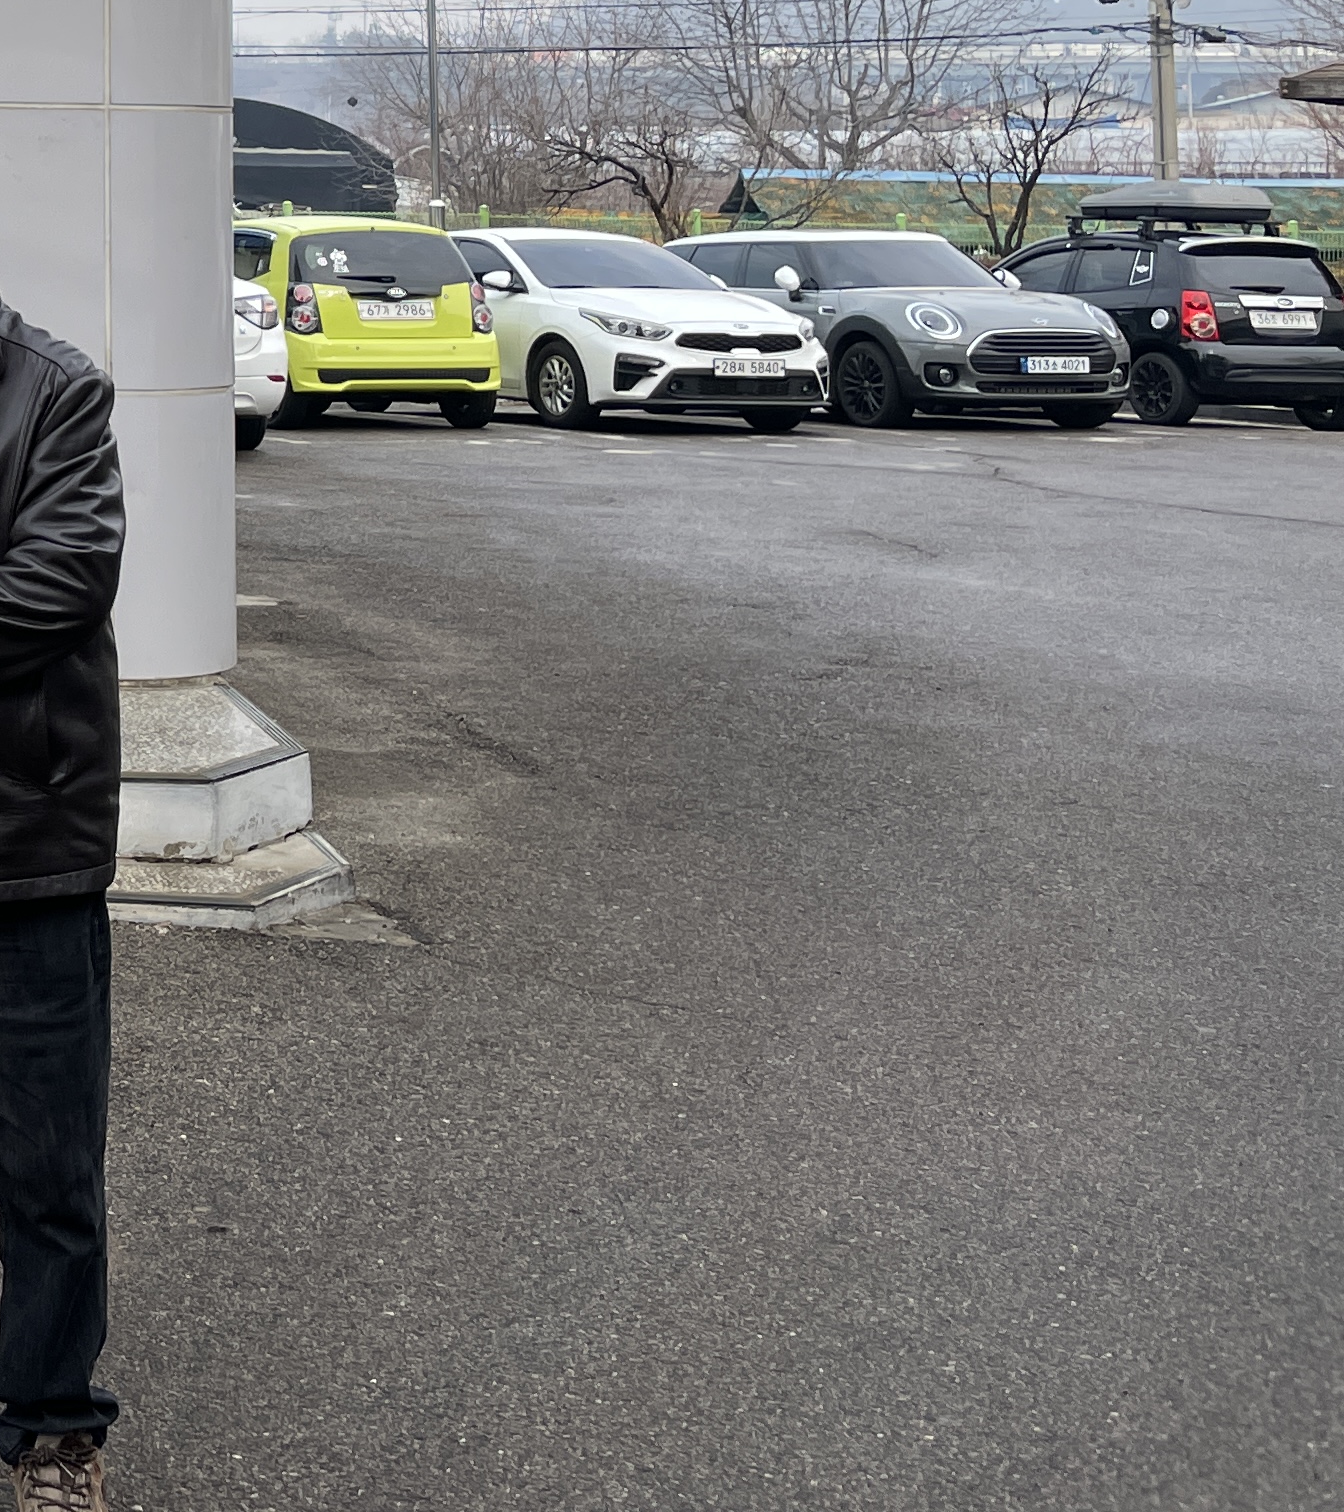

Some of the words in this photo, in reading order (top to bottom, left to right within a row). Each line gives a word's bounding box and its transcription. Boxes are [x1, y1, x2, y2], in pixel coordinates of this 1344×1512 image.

[395, 304, 426, 316] 2986
[751, 361, 779, 374] 5840
[1061, 359, 1086, 371] 4021
